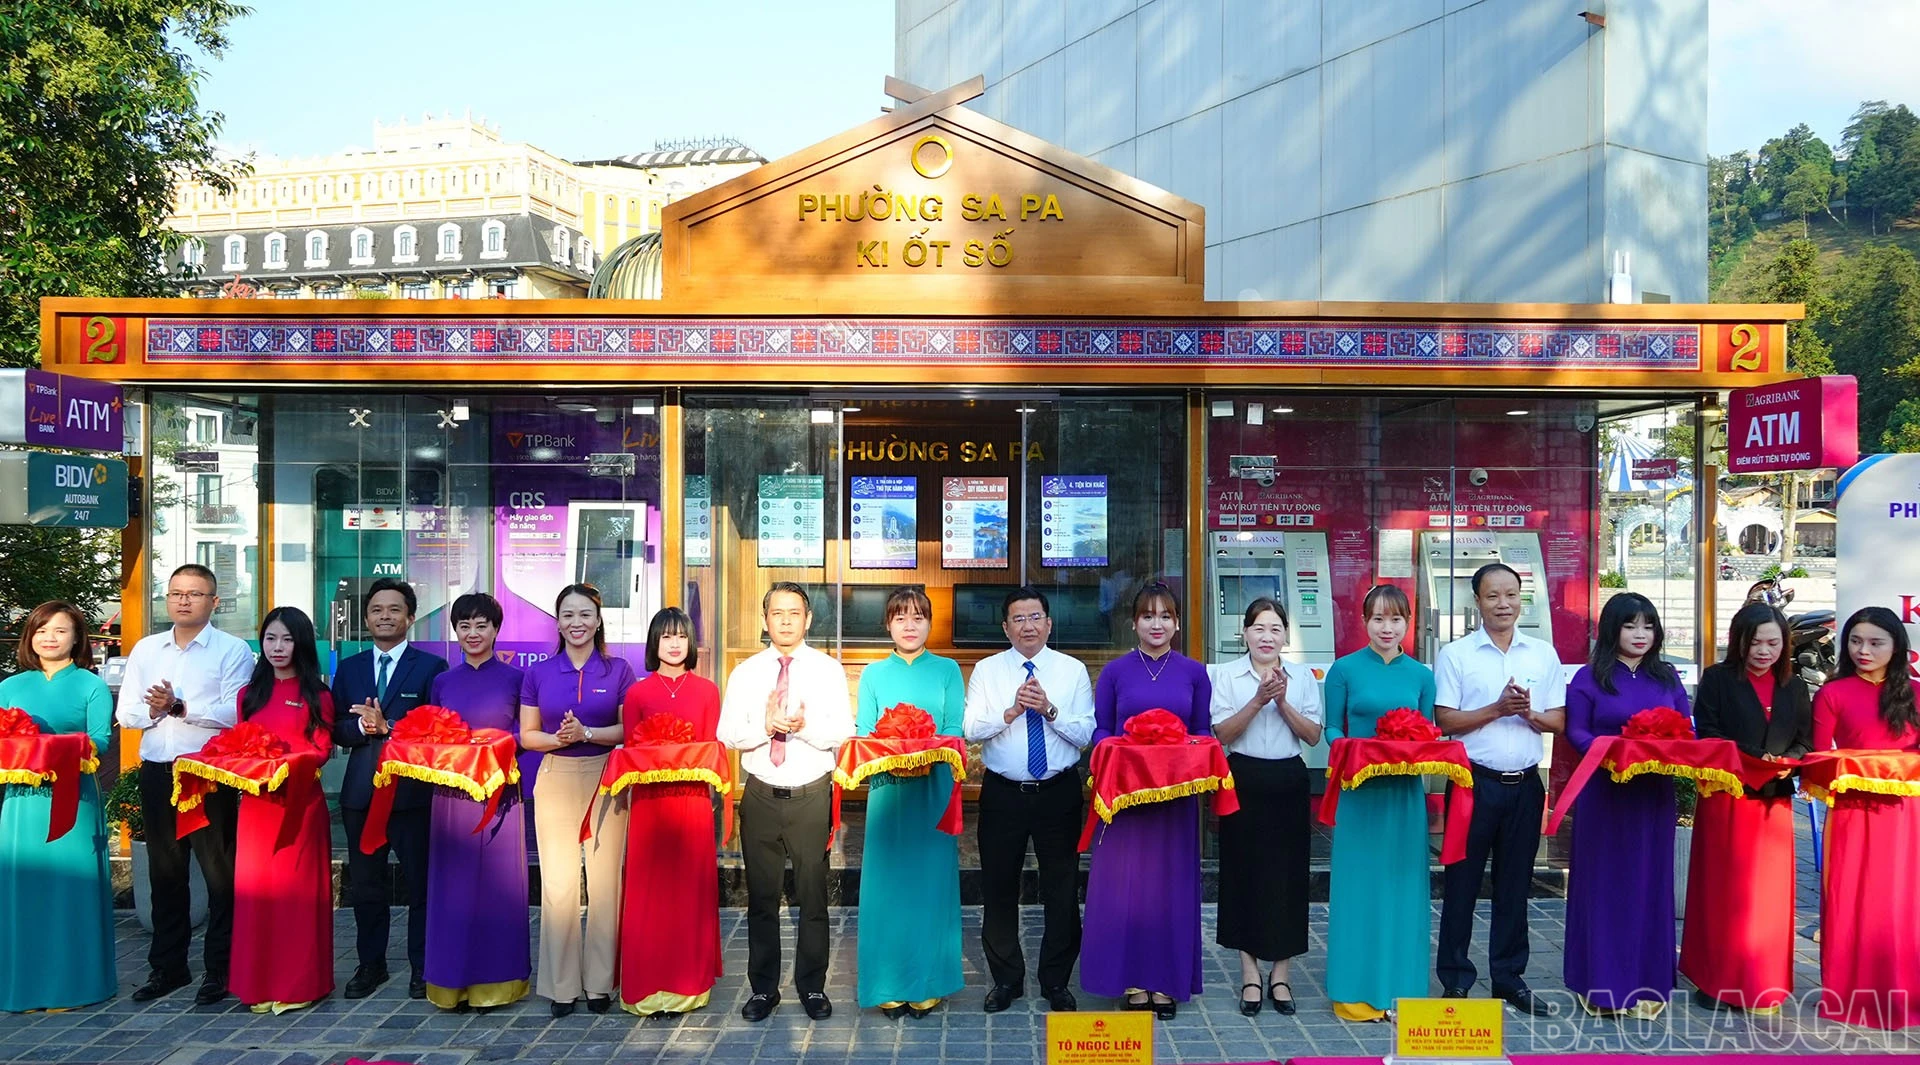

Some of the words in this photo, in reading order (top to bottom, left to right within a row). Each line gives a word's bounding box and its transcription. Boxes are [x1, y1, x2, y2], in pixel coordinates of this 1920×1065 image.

[799, 184, 943, 222] PHƯỜNG
[961, 193, 1007, 222] SA
[1020, 194, 1064, 222] PA
[857, 240, 888, 267] KI
[903, 227, 950, 267] ỐT
[963, 227, 1015, 267] SỐ
[86, 316, 118, 362] 2
[1731, 323, 1761, 371] 2
[36, 384, 58, 396] TPBank
[1755, 390, 1800, 406] AGRIBANK
[29, 406, 56, 424] Live
[66, 398, 109, 432] ATM
[39, 424, 55, 433] BANK
[1745, 411, 1799, 448] ATM
[525, 434, 576, 447] TPBank
[621, 427, 660, 448] Liv
[829, 433, 949, 462] PHƯỜNG
[960, 441, 998, 462] SA
[1008, 441, 1045, 462] PA
[55, 464, 94, 488] BIDV
[64, 494, 99, 504] AUTOBANK
[376, 487, 395, 496] BIDV
[1220, 491, 1243, 500] ATM
[1429, 492, 1452, 501] ATM
[509, 491, 546, 509] CRS
[1220, 502, 1239, 511] MÁY
[1241, 502, 1257, 511] RÚT
[74, 510, 90, 520] 24/7
[1889, 502, 1920, 518] PH
[372, 563, 402, 575] ATM
[517, 652, 549, 667] TPB
[1470, 1028, 1490, 1037] LAN
[1058, 1039, 1072, 1050] TÔ
[1077, 1040, 1110, 1052] NGỌC
